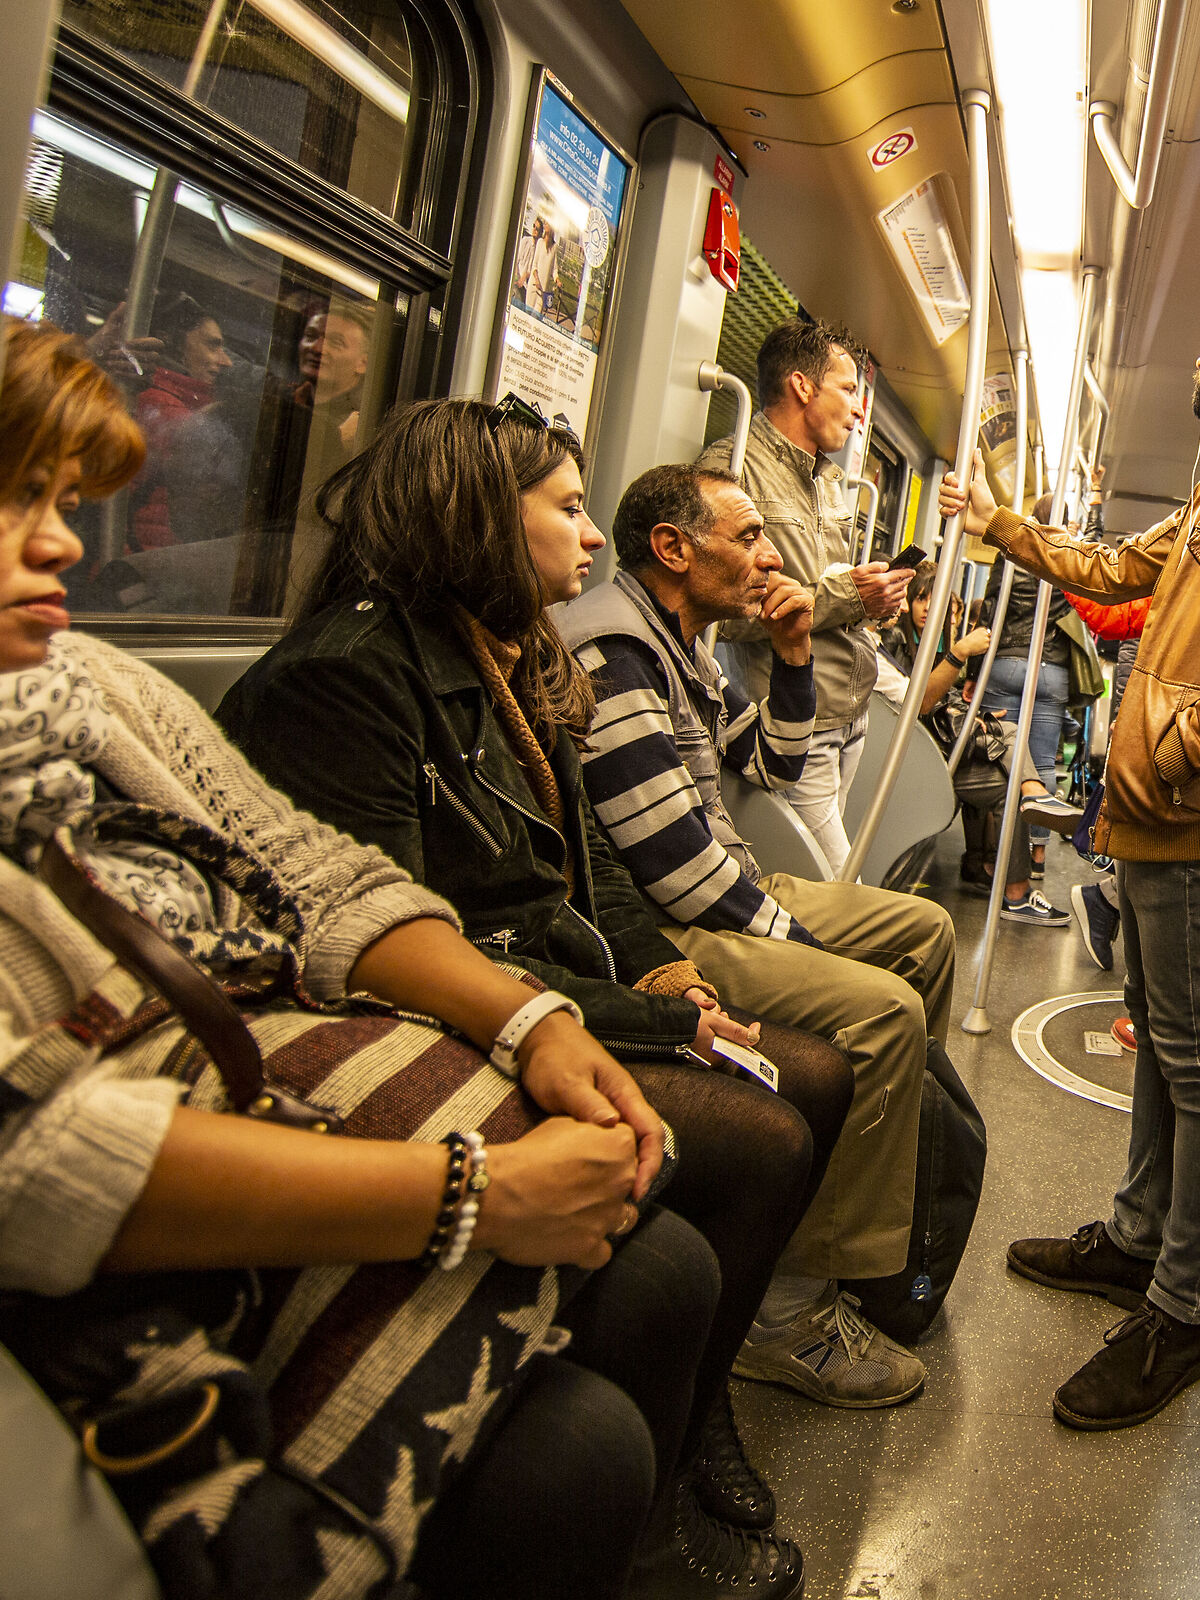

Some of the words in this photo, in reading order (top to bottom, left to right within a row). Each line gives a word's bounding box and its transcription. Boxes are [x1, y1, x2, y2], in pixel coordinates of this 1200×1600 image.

[570, 132, 578, 146] 02
[578, 139, 585, 153] 33
[585, 147, 592, 161] 91
